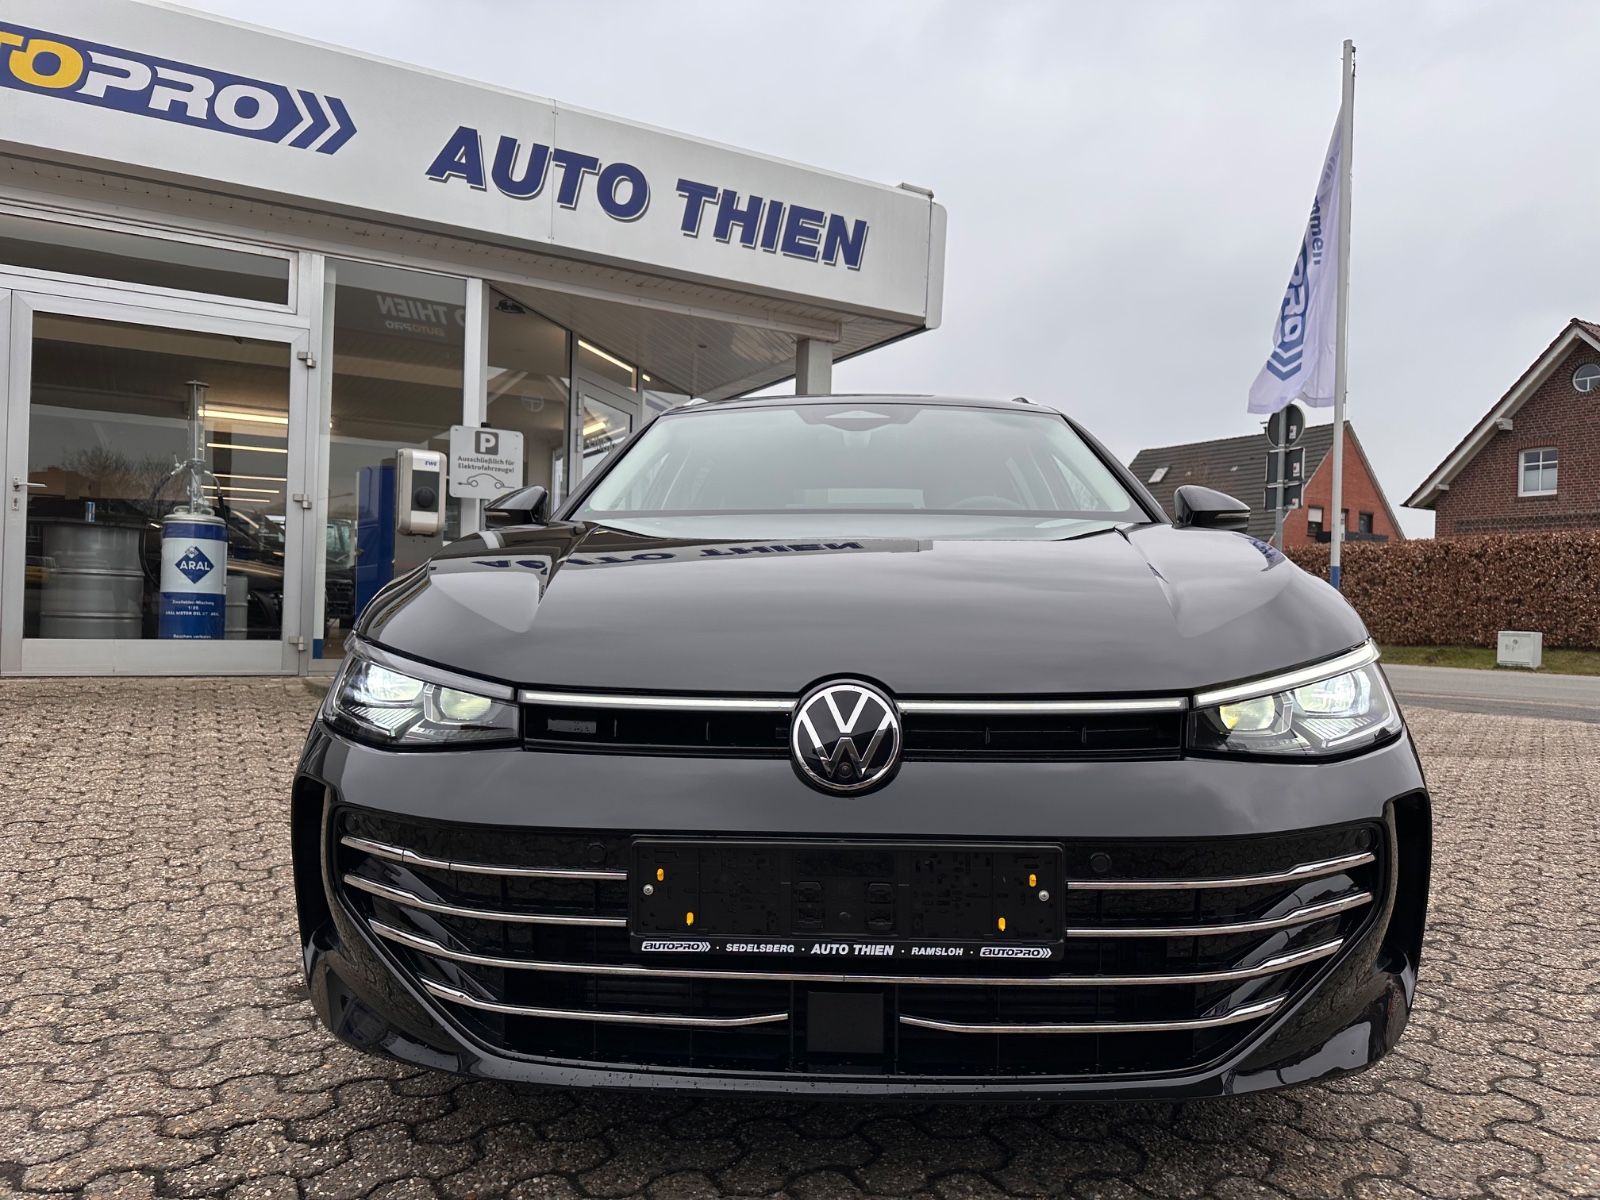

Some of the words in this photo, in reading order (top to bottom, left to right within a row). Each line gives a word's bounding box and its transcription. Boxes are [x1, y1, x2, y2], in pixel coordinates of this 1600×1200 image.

[425, 126, 650, 222] AUTO
[675, 178, 869, 271] THIEN
[480, 433, 496, 453] P
[180, 560, 210, 571] ARAL
[725, 943, 795, 953] SEDELSBERG
[810, 943, 849, 955] AUTO
[853, 944, 895, 956] THIEN
[911, 947, 964, 956] RAMSLOH
